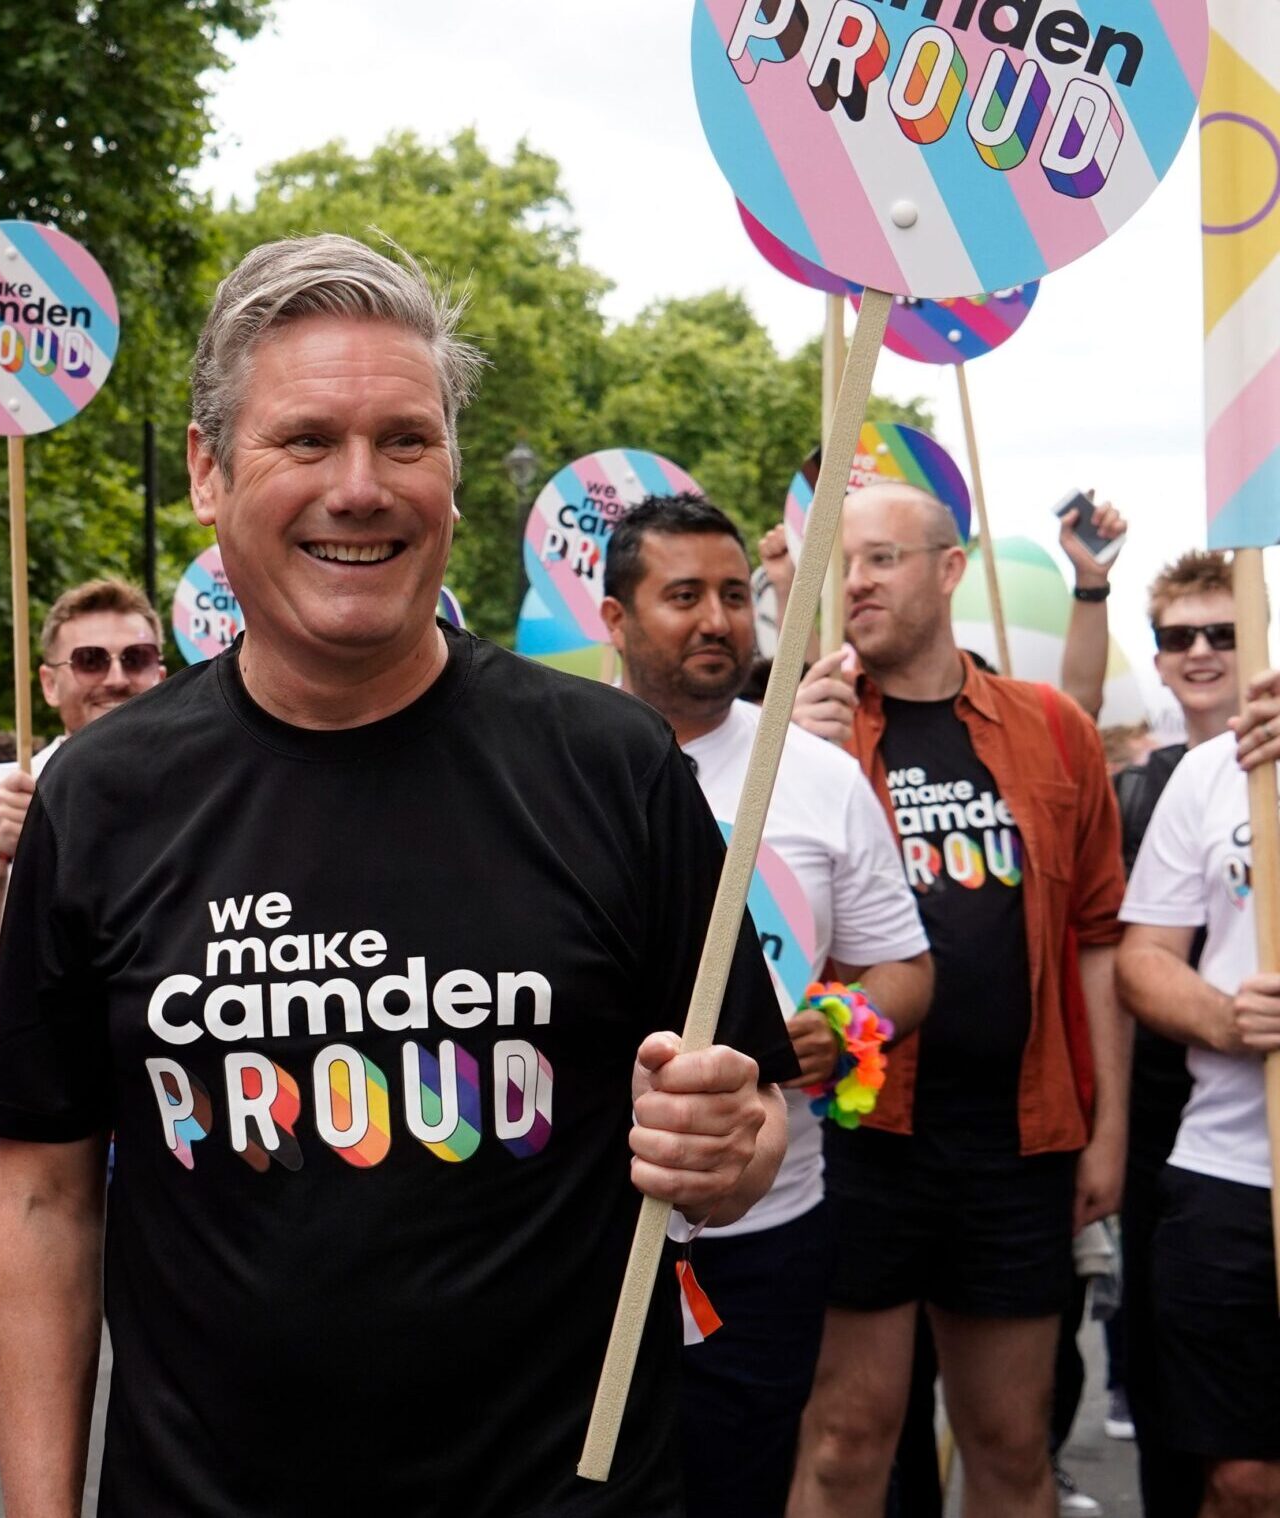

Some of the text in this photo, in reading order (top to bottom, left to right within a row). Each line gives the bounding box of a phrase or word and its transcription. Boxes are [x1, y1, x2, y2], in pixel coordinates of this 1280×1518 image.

[870, 0, 1144, 88] den
[726, 0, 1125, 199] PROUD
[586, 480, 618, 499] we
[195, 592, 237, 611] Ca
[887, 766, 926, 789] we
[889, 779, 975, 807] make
[208, 891, 293, 934] we
[206, 929, 388, 977] make
[146, 956, 553, 1045] Camden
[144, 1038, 554, 1173] PROUD
